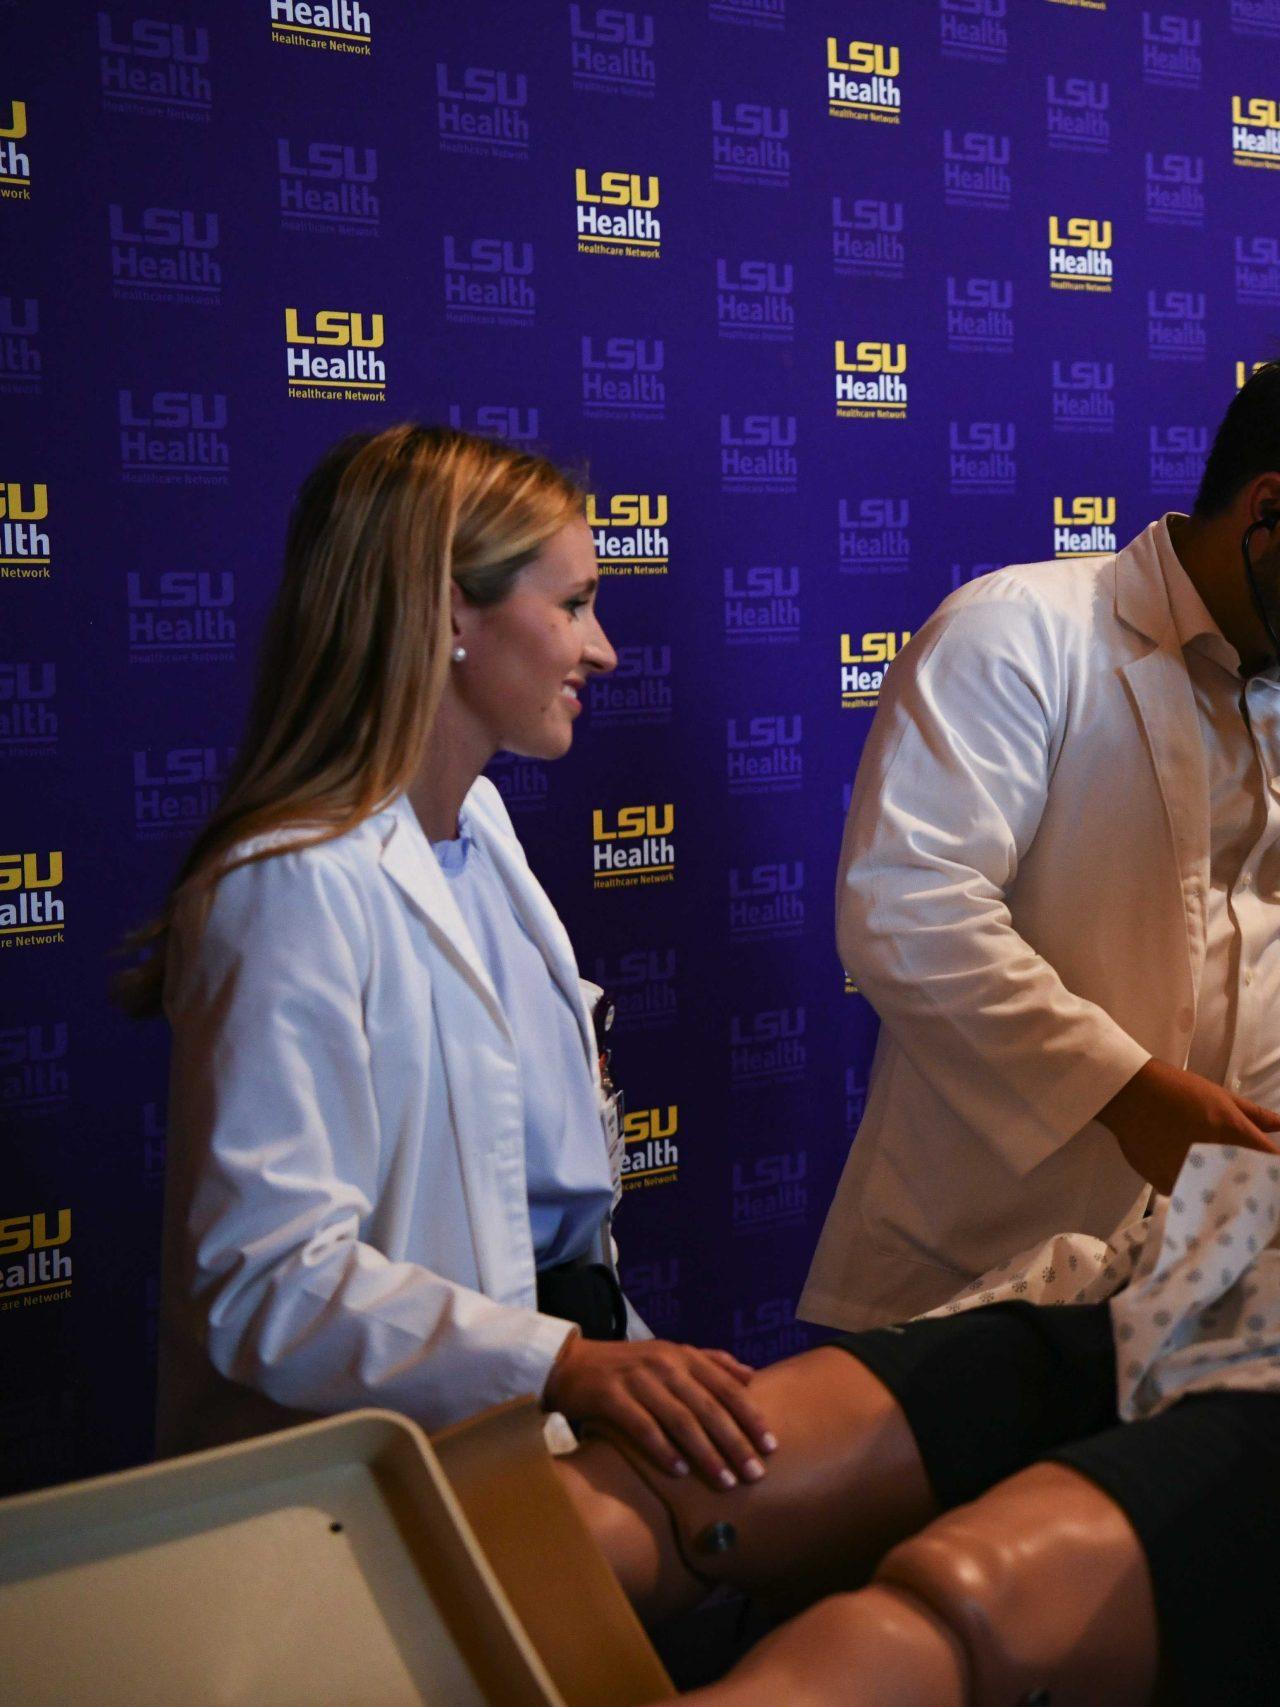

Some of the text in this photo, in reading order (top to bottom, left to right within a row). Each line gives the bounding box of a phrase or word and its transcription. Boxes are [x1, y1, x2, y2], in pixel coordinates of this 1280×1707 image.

[270, 0, 371, 33] Health
[569, 3, 654, 48] LSU
[271, 32, 372, 56] Healthcare Network
[827, 37, 900, 77] LSU
[436, 63, 527, 107] LSU
[828, 72, 901, 107] Health
[712, 100, 789, 139] LSU
[277, 138, 378, 182] LSU
[0, 187, 31, 200] work
[575, 168, 659, 209] LSU
[109, 203, 219, 249] LSU
[577, 206, 661, 240] Health
[1049, 216, 1112, 249] LSU
[444, 235, 534, 275] LSU
[578, 242, 660, 259] Healthcare Network
[1049, 247, 1113, 276] Health
[717, 258, 793, 294] LSU
[285, 307, 384, 348] LSU
[287, 347, 386, 382] Health
[581, 335, 664, 372] LSU
[835, 340, 907, 374] LSU
[288, 387, 386, 402] Healthcare Network
[836, 373, 908, 402] Health
[118, 389, 228, 430] LSU
[720, 414, 797, 447] LSU
[586, 494, 668, 527] LSU
[1053, 496, 1116, 526] LSU
[0, 523, 50, 556] lth
[1054, 527, 1116, 552] Health
[1, 567, 50, 579] Network
[597, 564, 668, 577] althcare Network
[725, 567, 799, 597] LSU
[127, 571, 235, 608] LSU
[727, 715, 802, 747] LSU
[592, 803, 674, 842] LSU
[594, 833, 675, 870] Health
[0, 850, 63, 891] SU
[594, 871, 674, 890] Healthcare Network
[0, 891, 64, 926] alth
[16, 932, 64, 947] Network
[624, 1105, 678, 1143] SU
[621, 1138, 678, 1173] ealth
[0, 1208, 72, 1255] SU
[0, 1249, 72, 1290] alth
[23, 1288, 72, 1307] Network
